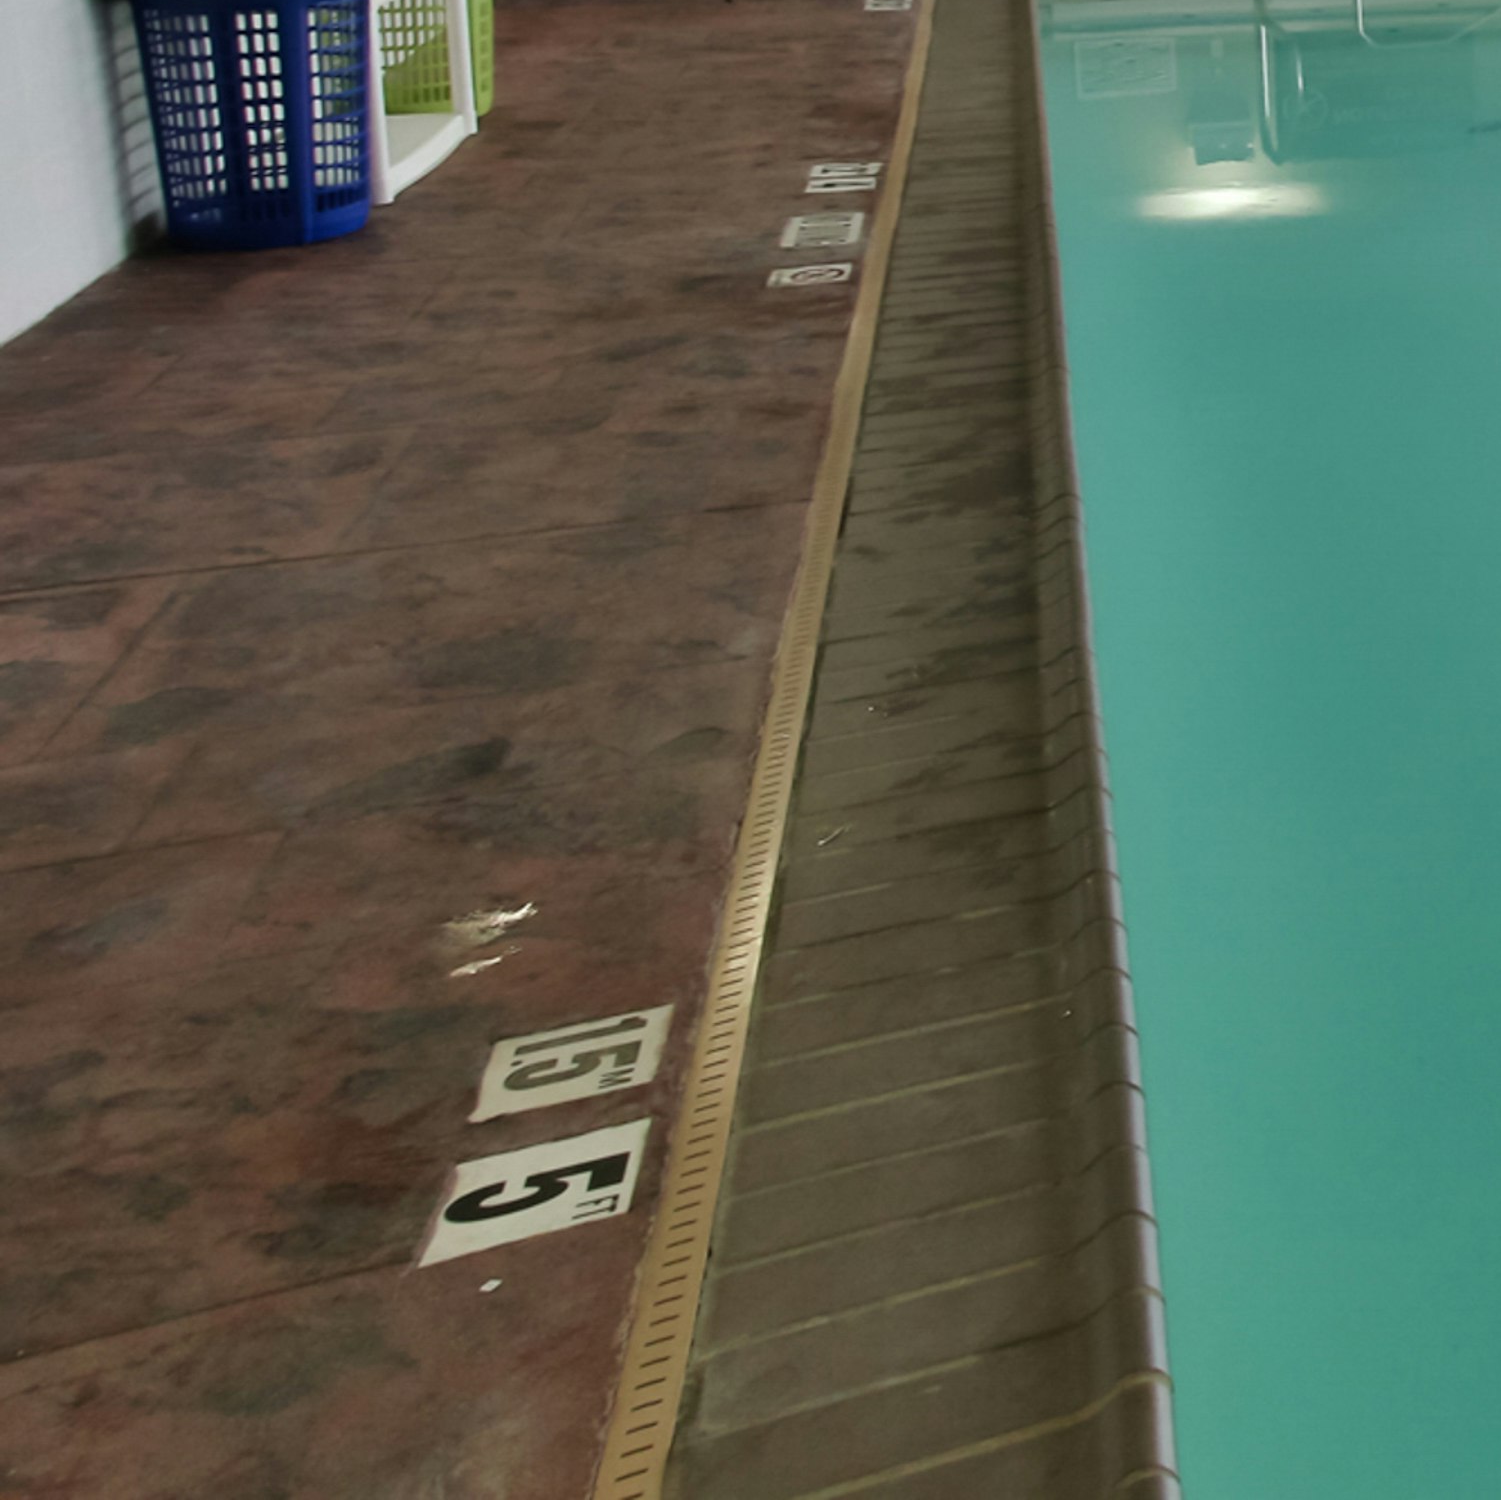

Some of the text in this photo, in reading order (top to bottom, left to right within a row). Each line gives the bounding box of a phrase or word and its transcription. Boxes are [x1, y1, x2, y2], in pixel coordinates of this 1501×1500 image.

[503, 1015, 648, 1091] 1.5 M
[444, 1151, 631, 1224] 5 FT
